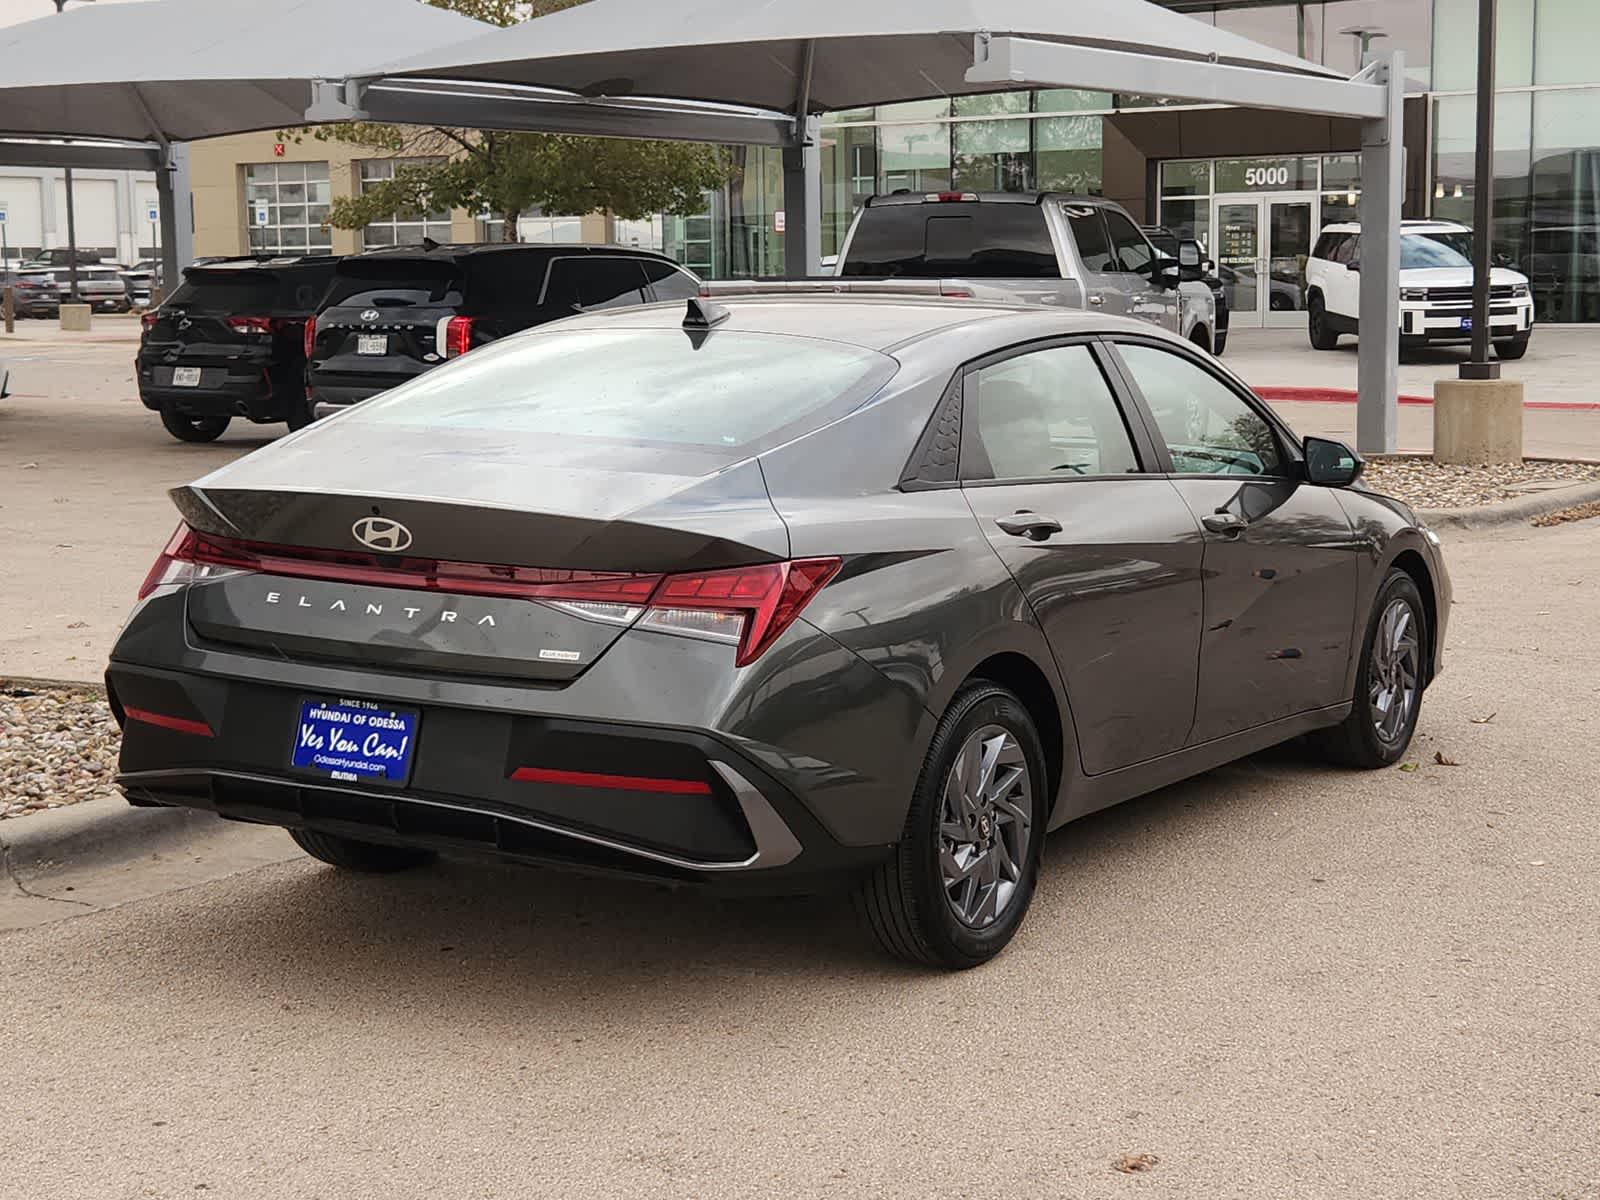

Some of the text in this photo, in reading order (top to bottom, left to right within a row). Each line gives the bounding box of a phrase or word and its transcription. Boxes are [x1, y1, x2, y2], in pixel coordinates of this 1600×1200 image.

[1245, 167, 1288, 185] 5000
[266, 592, 496, 626] ELANTRA
[339, 698, 378, 710] SINCE 1946
[309, 708, 406, 731] HYUNDAI OF ODESSA
[300, 723, 409, 760] Yes You Can!
